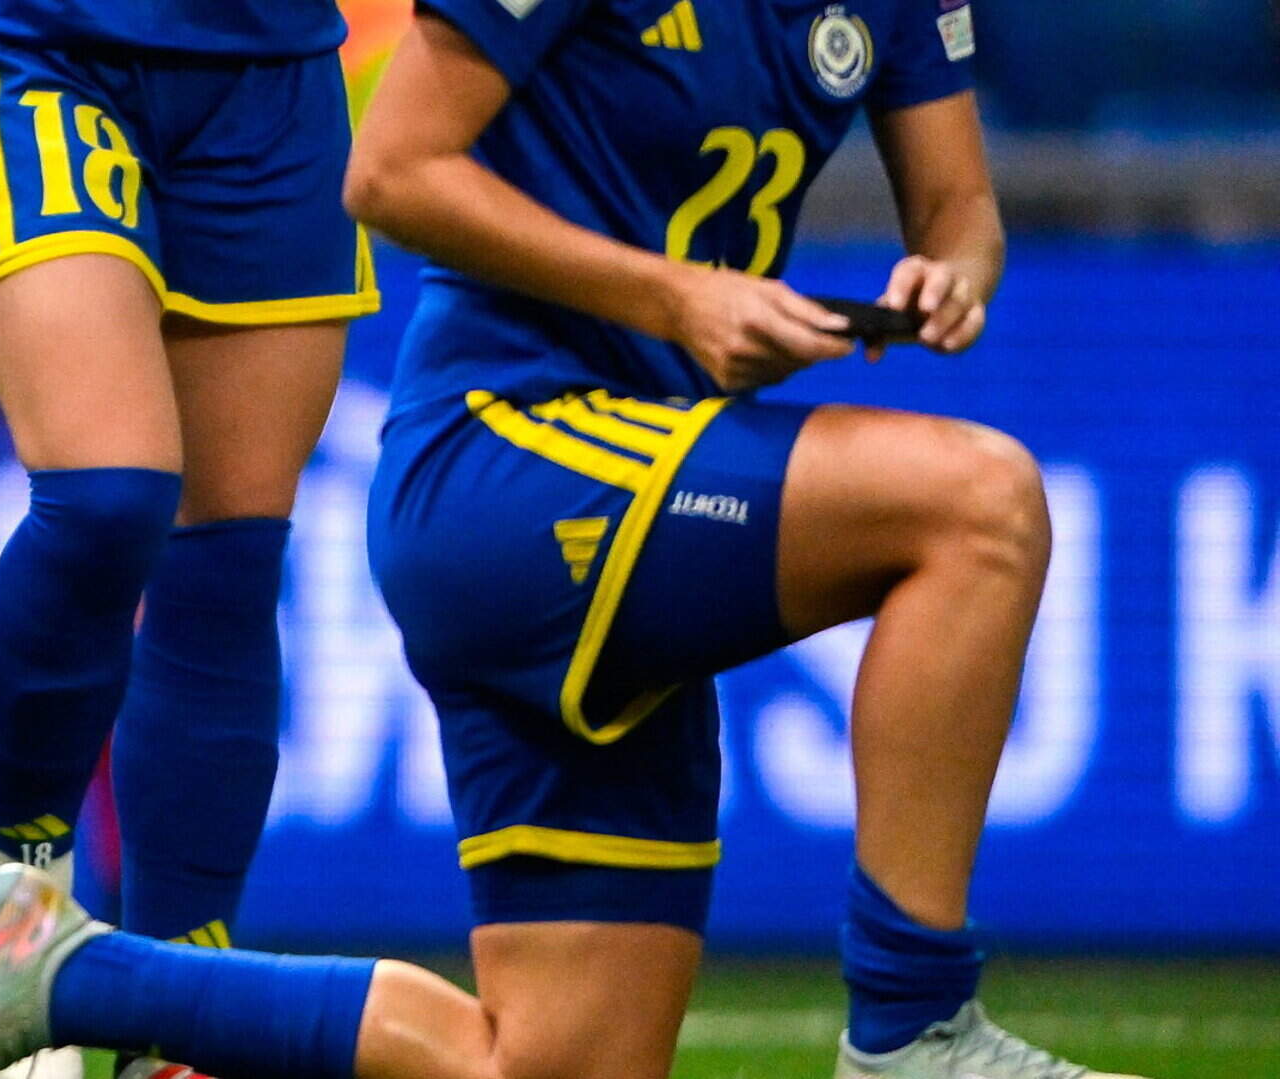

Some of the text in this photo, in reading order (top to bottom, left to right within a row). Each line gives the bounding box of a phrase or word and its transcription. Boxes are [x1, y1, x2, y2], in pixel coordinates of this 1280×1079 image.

[18, 90, 141, 228] 18
[665, 125, 806, 278] 23
[20, 841, 53, 870] 18
